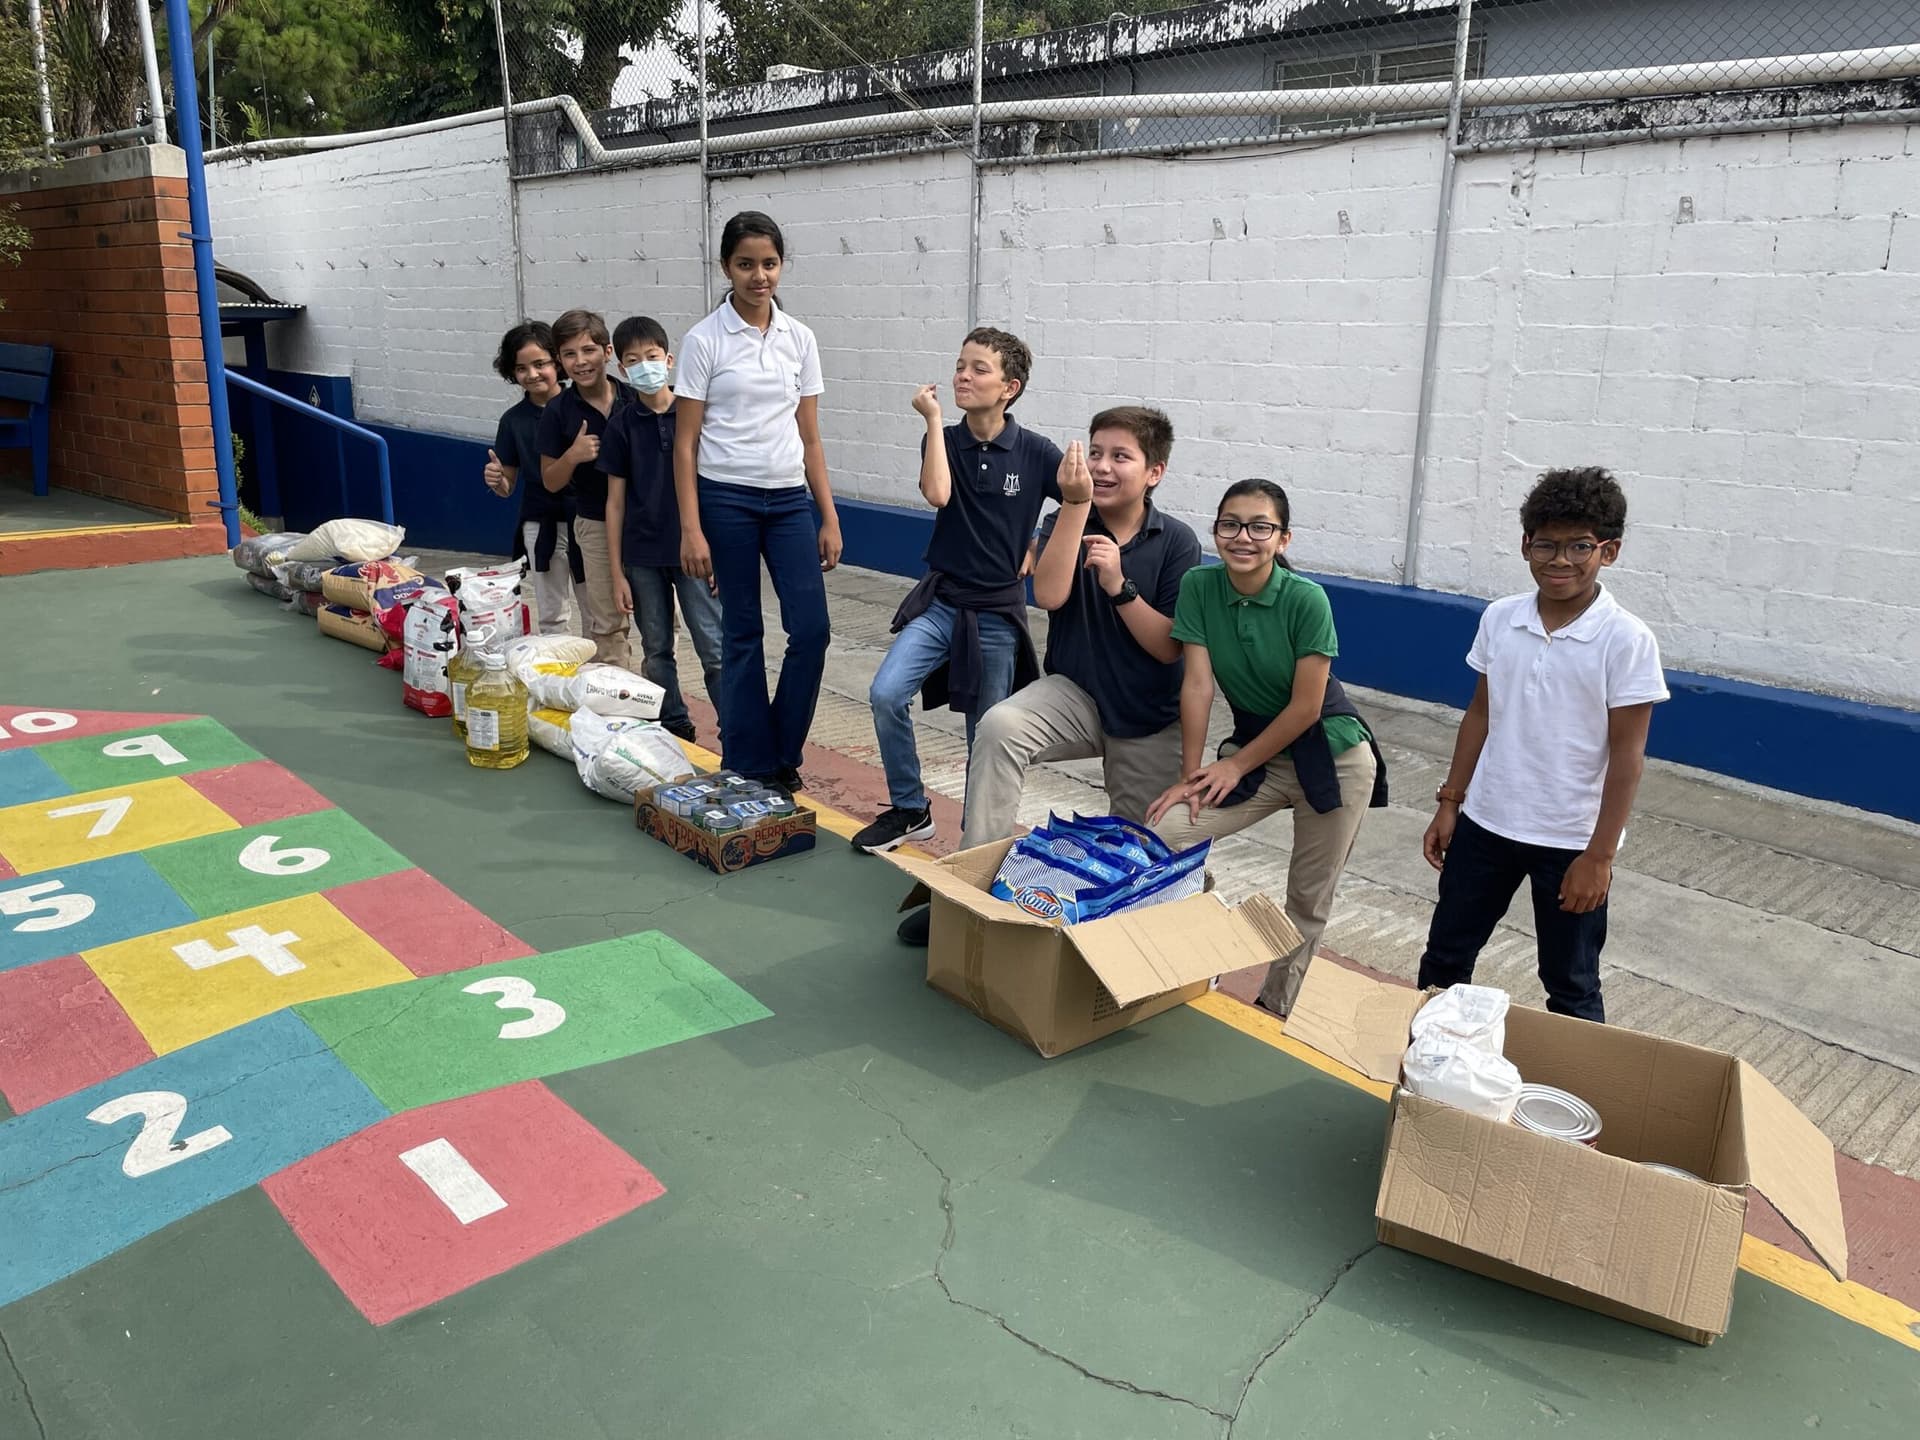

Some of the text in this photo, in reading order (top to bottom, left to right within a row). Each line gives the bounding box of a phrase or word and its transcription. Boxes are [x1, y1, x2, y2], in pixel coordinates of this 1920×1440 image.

[103, 734, 189, 766] 9
[47, 796, 133, 839] 7
[755, 820, 797, 842] BERRIES
[239, 835, 331, 875] 6
[0, 880, 96, 932] 5
[1015, 887, 1061, 916] Roma
[172, 925, 306, 977] 4
[461, 976, 566, 1039] 3
[86, 1091, 233, 1178] 2
[398, 1138, 509, 1225] 1
